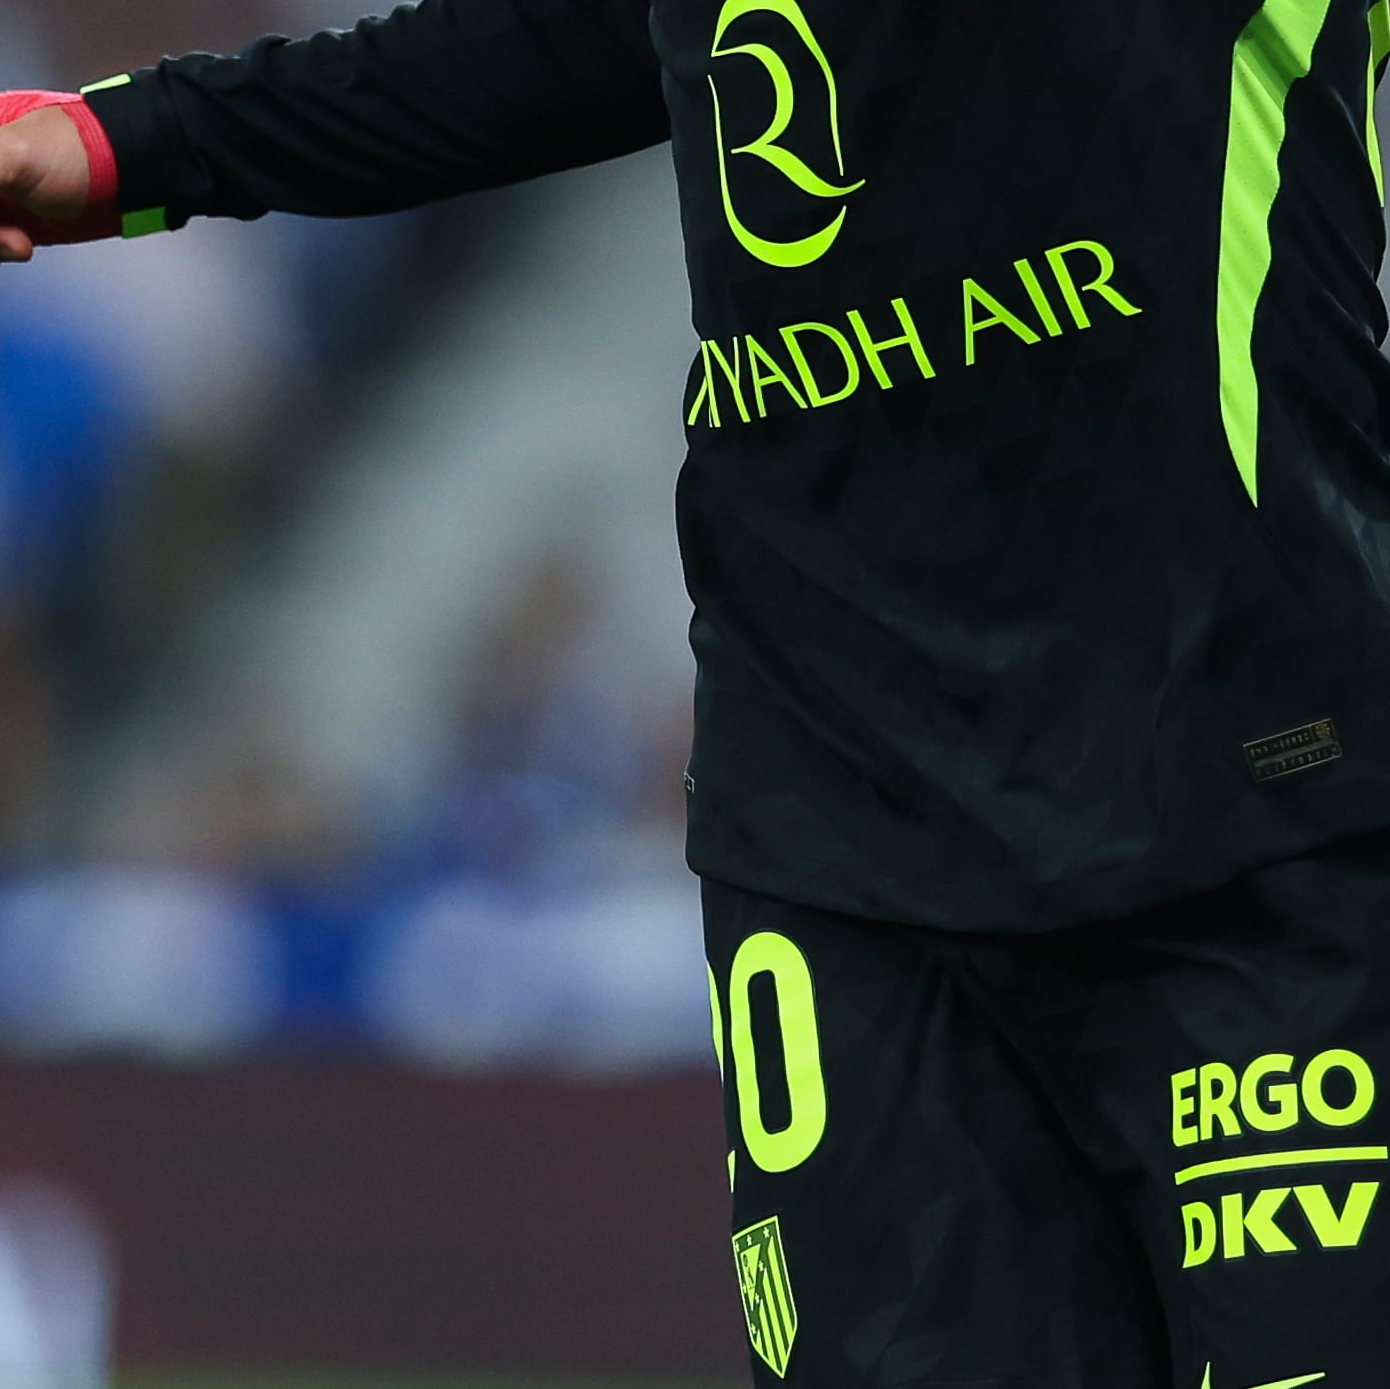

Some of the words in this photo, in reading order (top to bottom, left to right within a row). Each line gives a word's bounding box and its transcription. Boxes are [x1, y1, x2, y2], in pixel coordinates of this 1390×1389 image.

[962, 240, 1143, 366] AIR
[707, 931, 827, 1173] 0
[1170, 1048, 1375, 1148] ERGO
[1180, 1181, 1380, 1268] DKV
